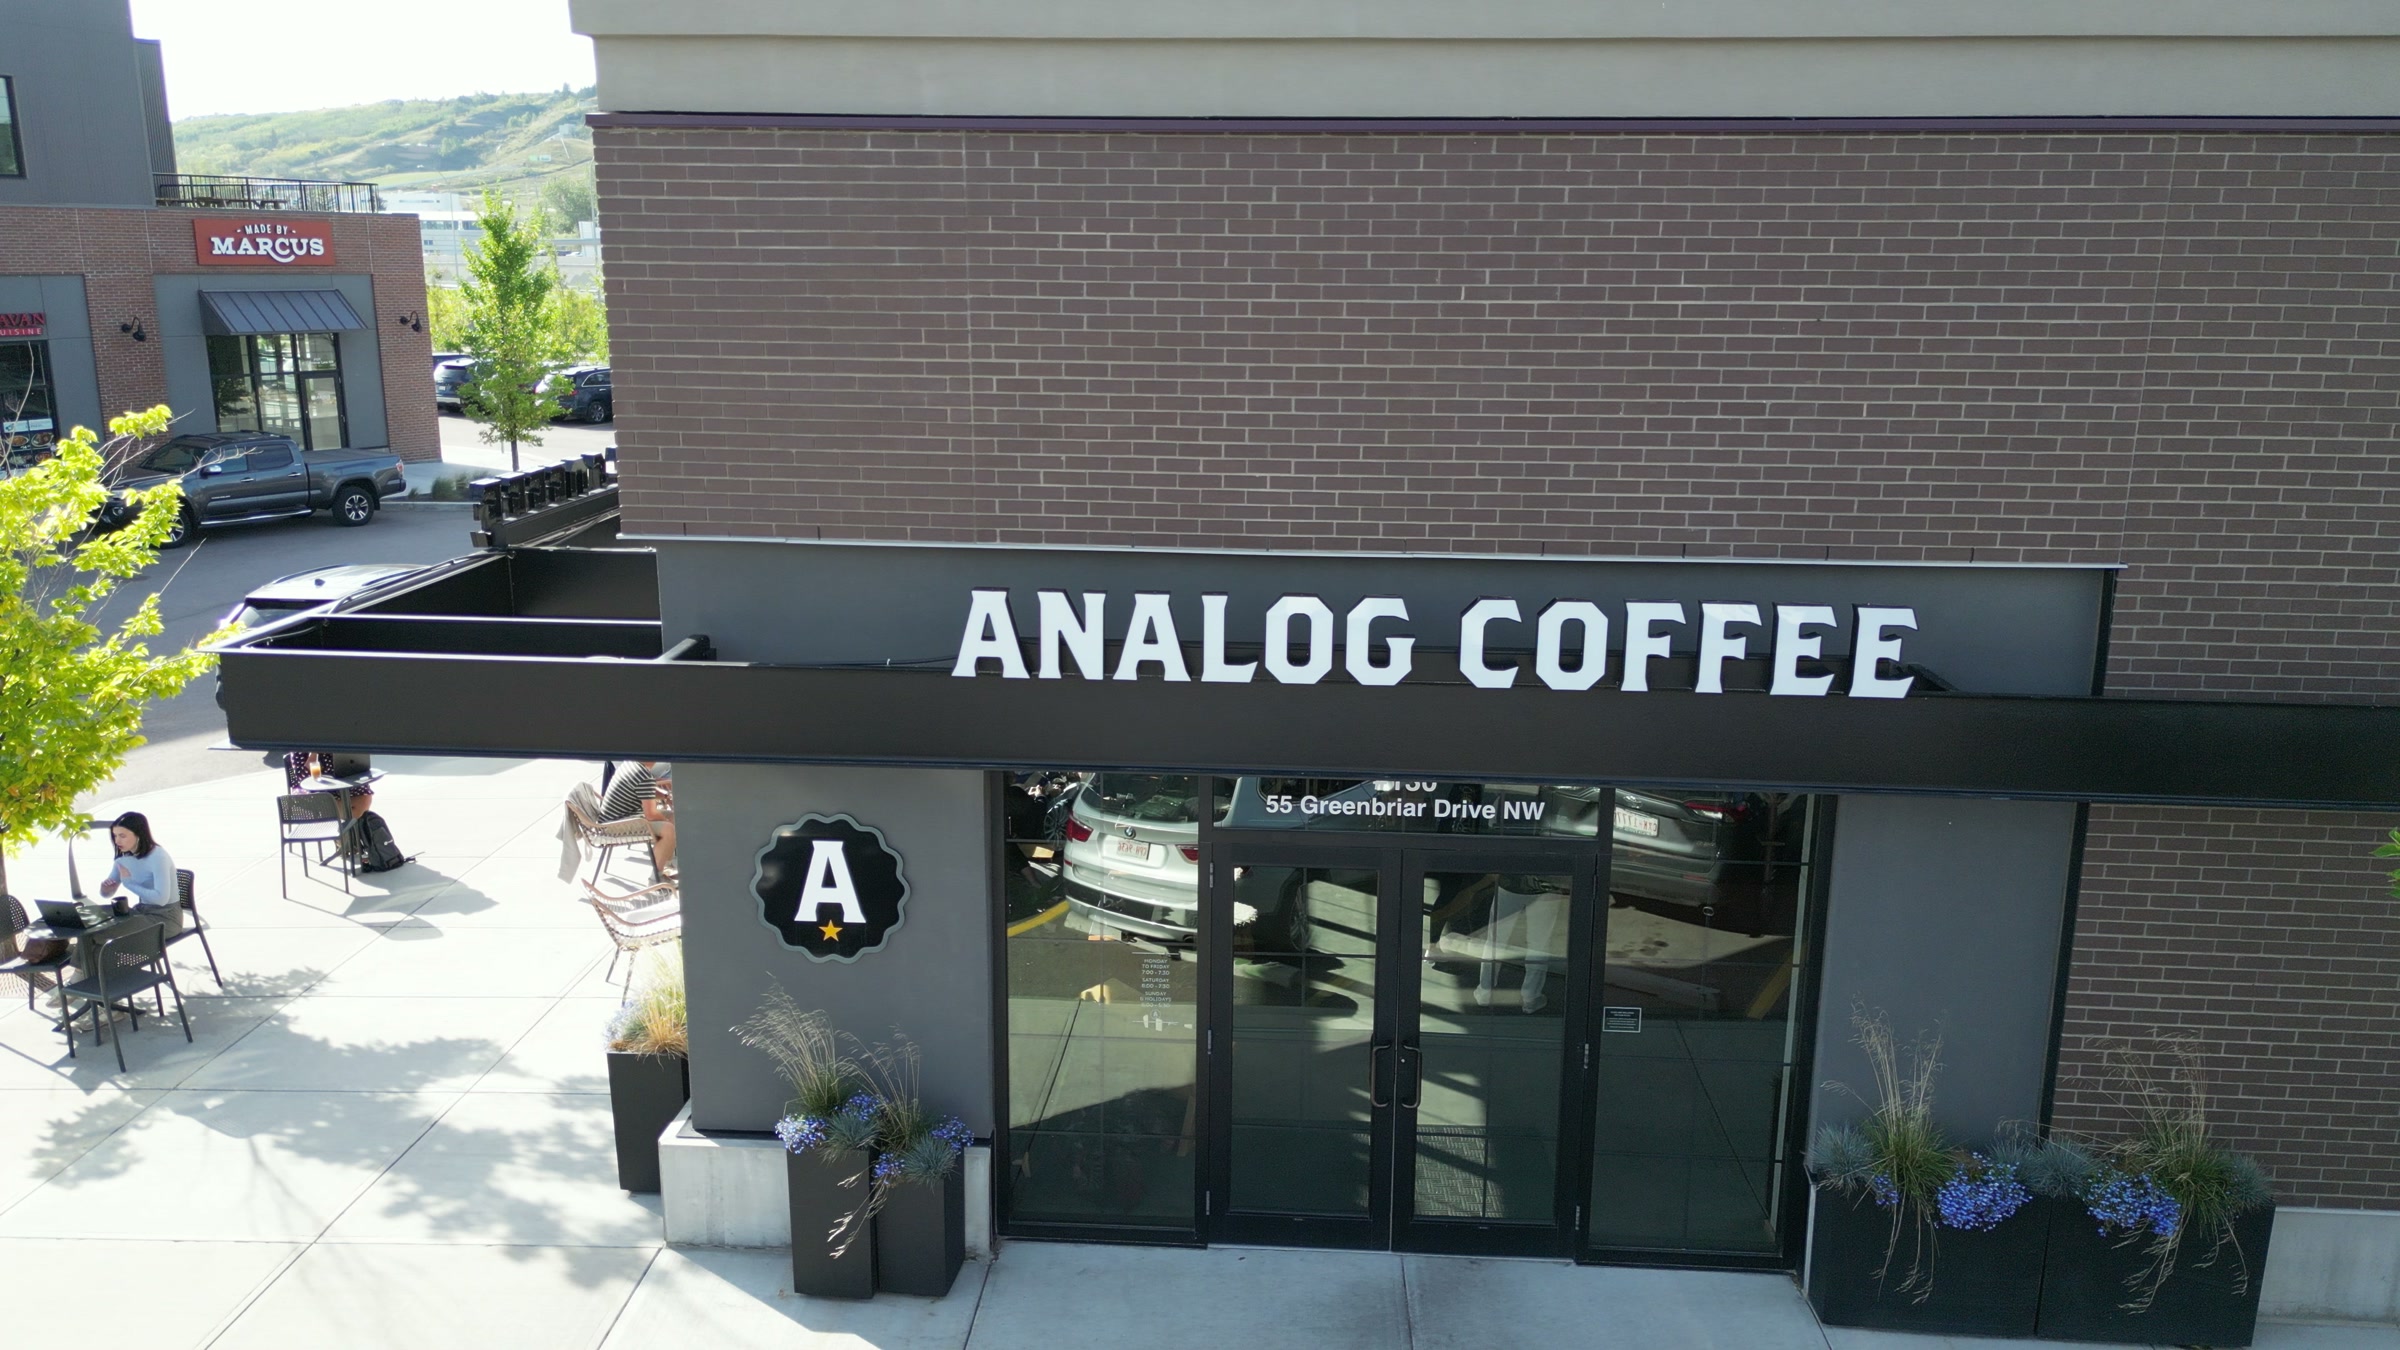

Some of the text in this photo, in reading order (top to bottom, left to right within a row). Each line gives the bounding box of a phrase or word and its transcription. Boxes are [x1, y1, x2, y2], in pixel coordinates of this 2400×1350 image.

[244, 223, 288, 235] MADE BY
[210, 236, 325, 263] MARCUS
[951, 589, 1919, 698] ANALOG COFFEE
[1265, 795, 1545, 820] 55 Greenbriar Drive NW
[794, 840, 867, 924] A
